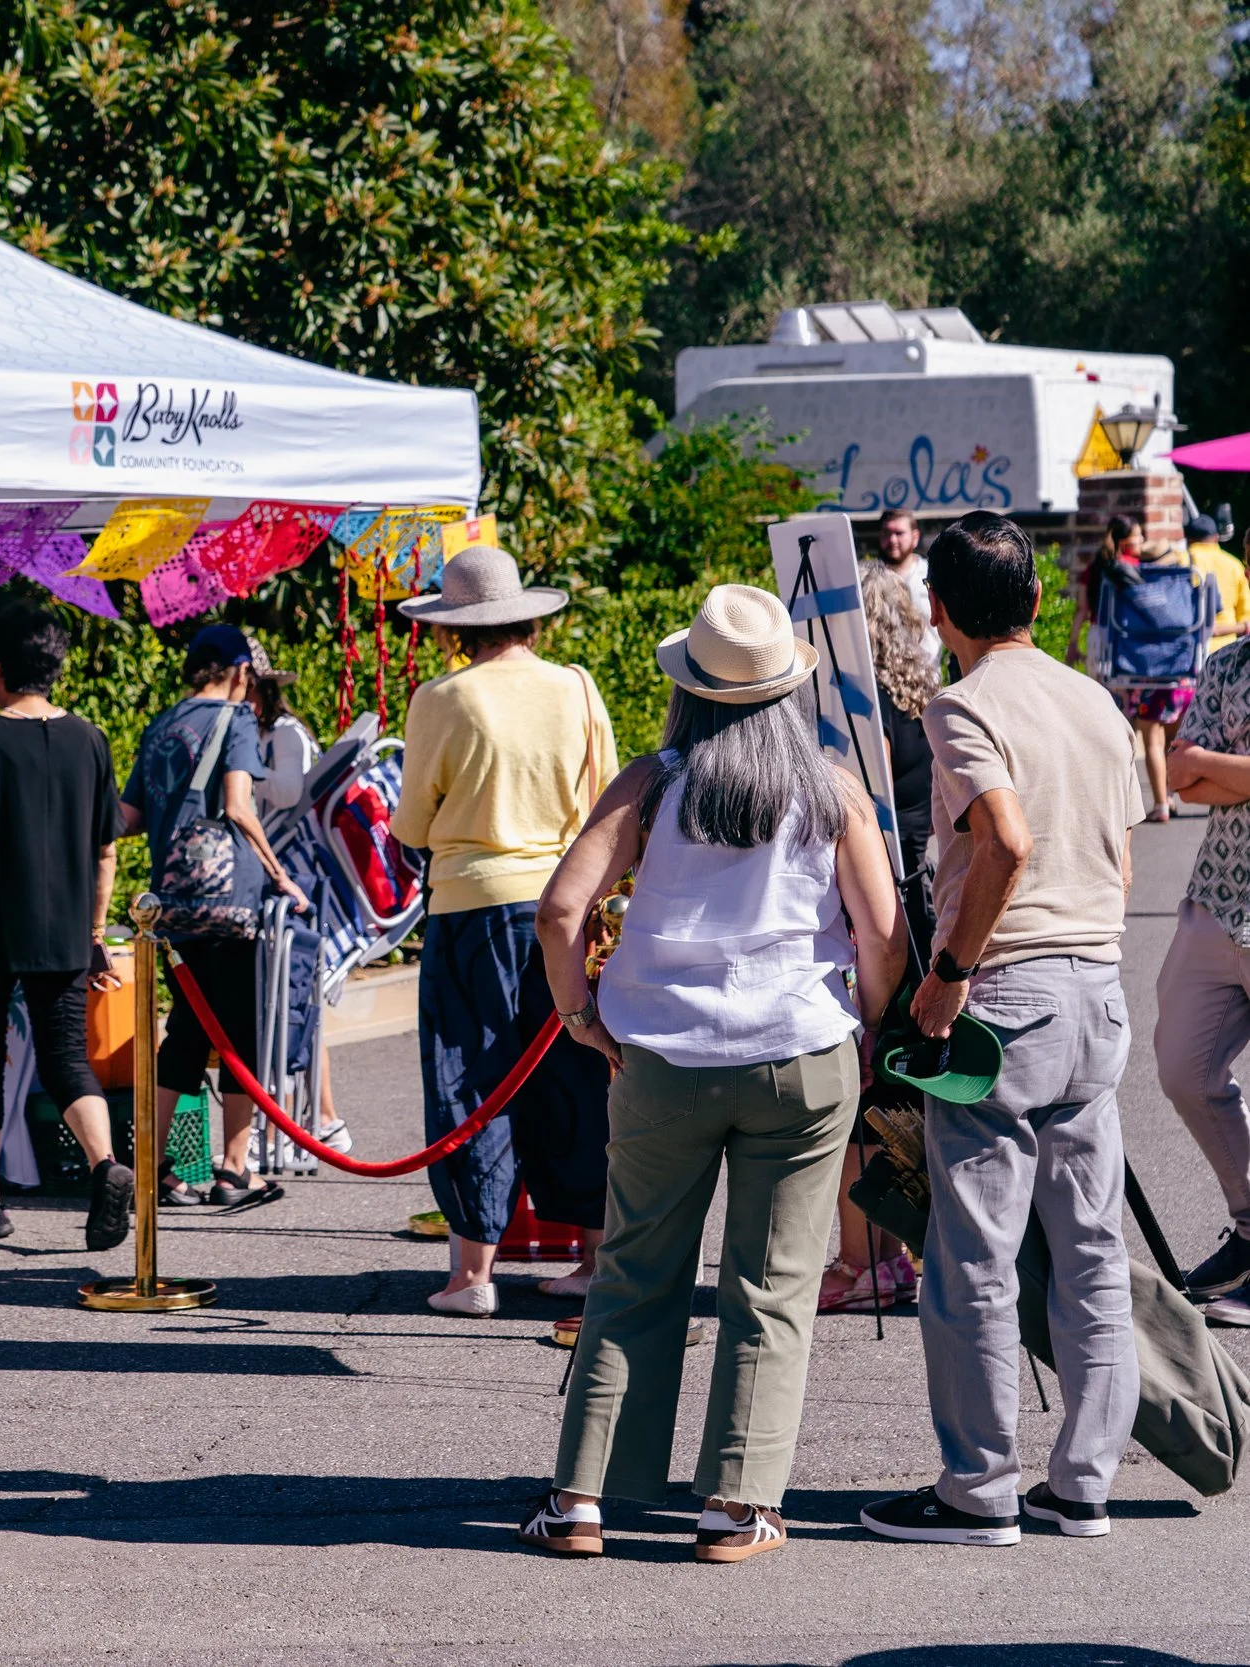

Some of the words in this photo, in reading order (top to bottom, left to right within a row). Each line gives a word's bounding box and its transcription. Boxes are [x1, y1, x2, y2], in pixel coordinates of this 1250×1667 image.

[122, 383, 186, 442] Bixby
[161, 388, 244, 446] Knolls
[120, 455, 180, 470] COMMUNITY
[183, 457, 244, 473] FOUNDATION
